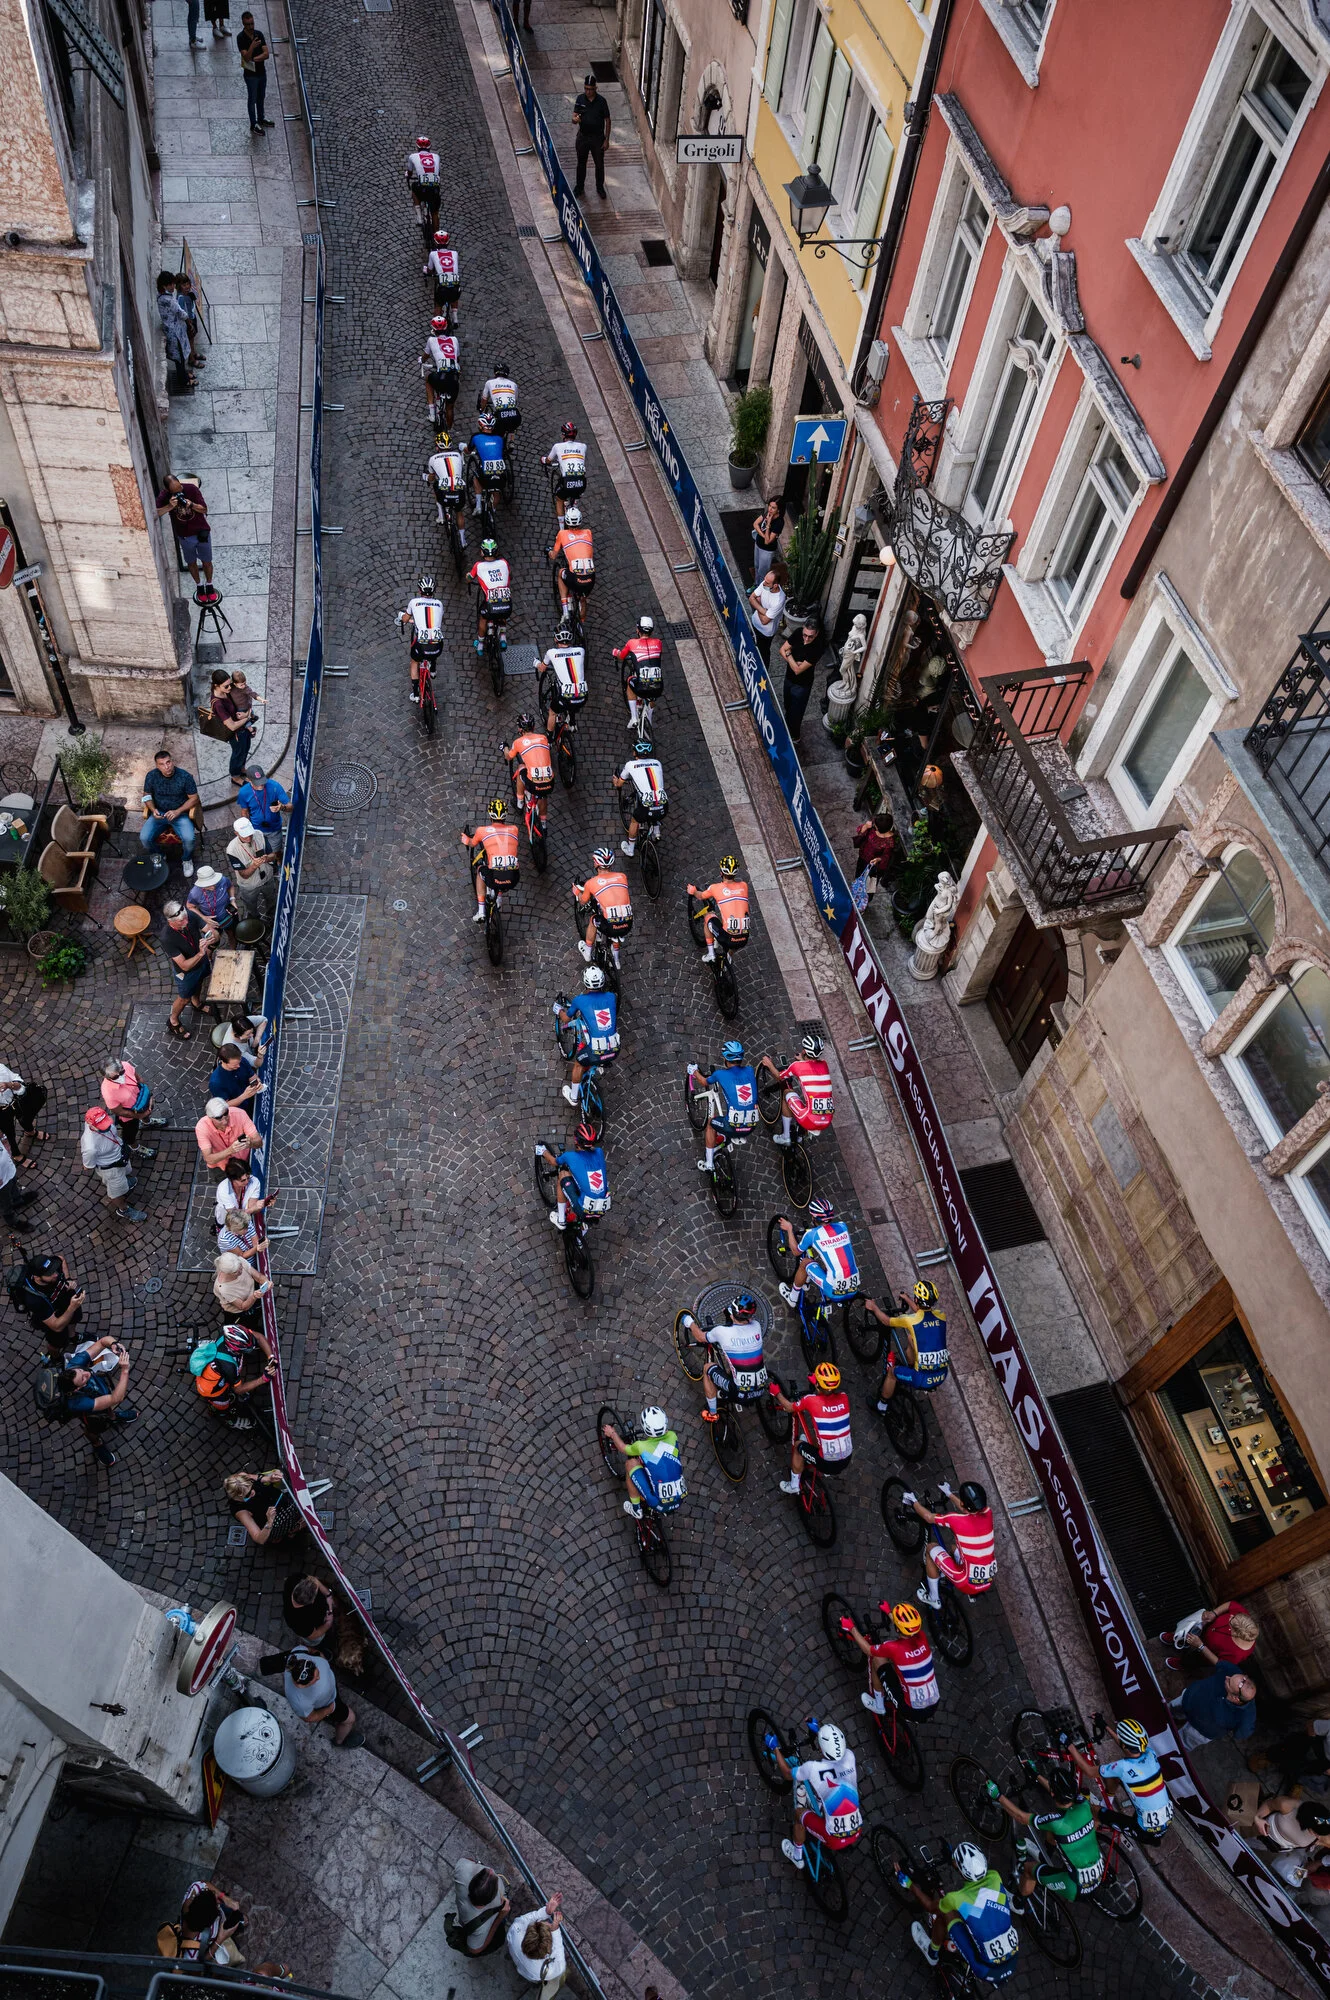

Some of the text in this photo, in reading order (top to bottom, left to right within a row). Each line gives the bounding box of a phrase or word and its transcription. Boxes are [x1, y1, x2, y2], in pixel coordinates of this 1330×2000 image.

[684, 143, 735, 161] Grigoli
[562, 193, 592, 273] TRENTINO
[500, 410, 517, 419] ESPAÑA
[644, 388, 680, 482] TRENTINO
[485, 460, 504, 471] 89 89
[566, 481, 584, 490] ESPAÑA
[738, 631, 775, 746] TRENTINO
[494, 856, 503, 867] 12
[816, 855, 835, 903] BONDONE
[846, 920, 967, 1254] ITAS ASSICURAZIONI
[813, 1098, 823, 1110] 65
[820, 1233, 849, 1247] STRABAG
[835, 1280, 847, 1291] 39
[923, 1320, 940, 1328] SWE
[920, 1353, 935, 1365] 142
[740, 1374, 752, 1387] 95
[926, 1373, 945, 1385] SWE
[822, 1403, 845, 1413] NOR
[825, 1441, 836, 1454] 15
[801, 1450, 817, 1464] NOR
[967, 1267, 1140, 1697] ITAS ASSICURAZIONI
[661, 1484, 673, 1498] 60
[973, 1565, 986, 1579] 66
[905, 1645, 927, 1659] NOR
[882, 1681, 898, 1709] NOR
[914, 1688, 925, 1700] 18
[1127, 1768, 1138, 1779] EY
[834, 1817, 846, 1833] 84
[1037, 1812, 1062, 1824] IRELAND
[1146, 1812, 1160, 1828] 43
[1067, 1820, 1095, 1843] IRELAND
[1080, 1869, 1097, 1885] 119
[1046, 1880, 1066, 1891] IRELAND
[989, 1940, 1004, 1957] 63
